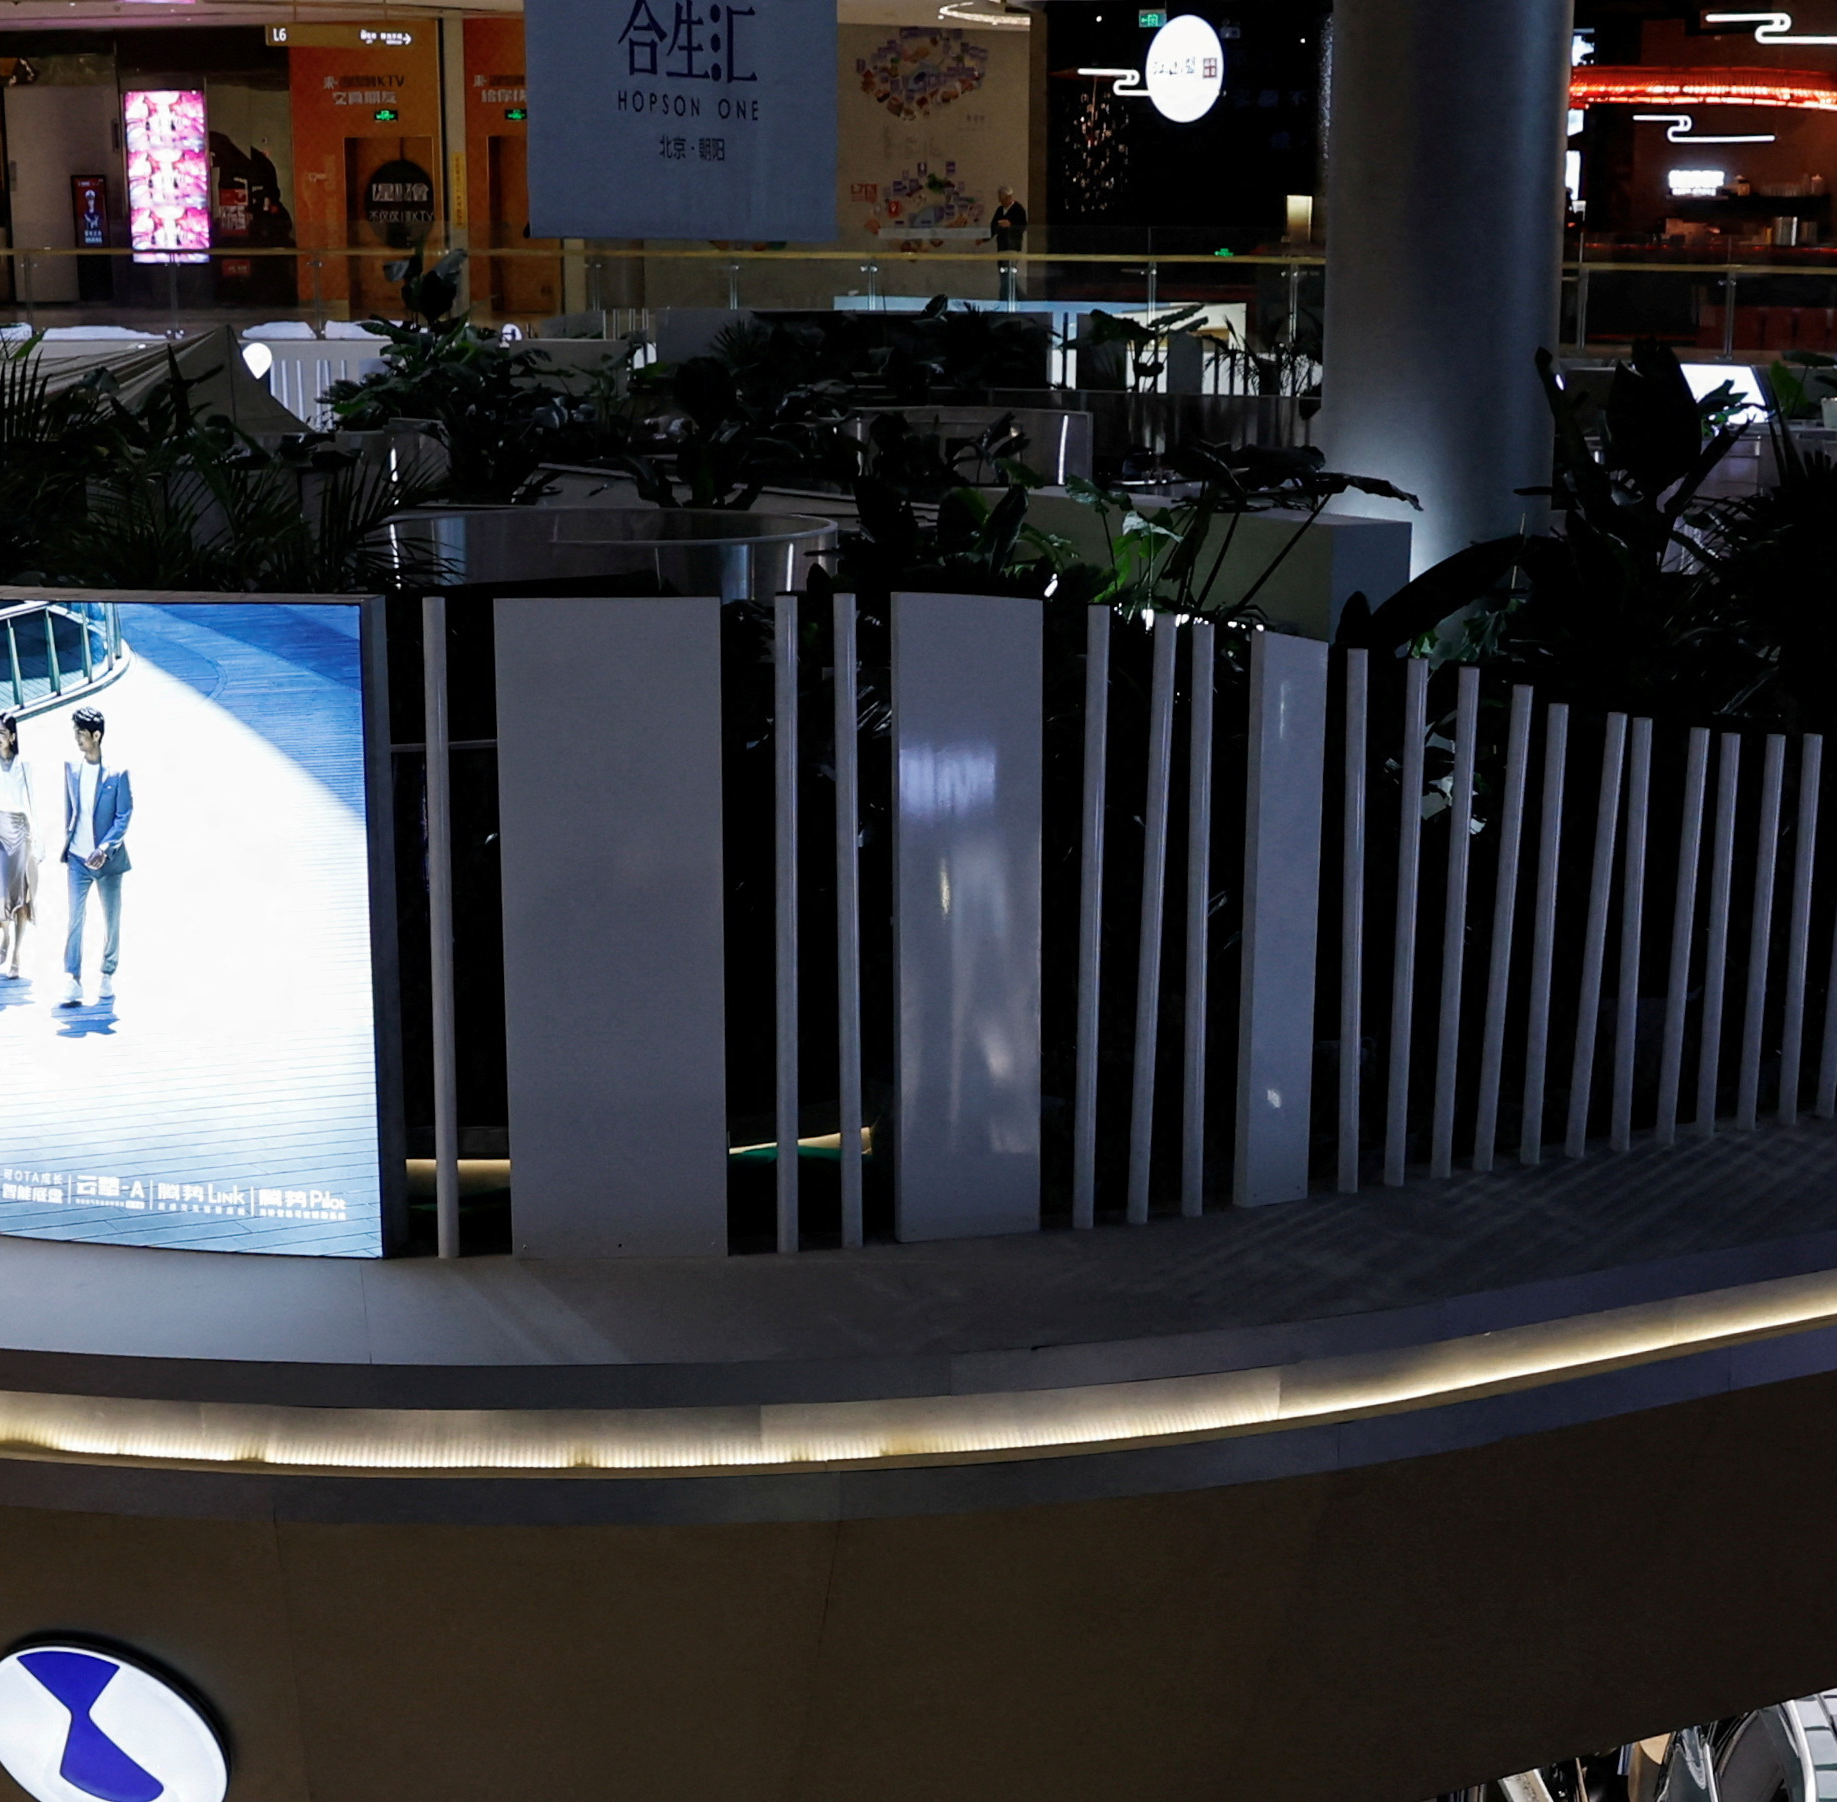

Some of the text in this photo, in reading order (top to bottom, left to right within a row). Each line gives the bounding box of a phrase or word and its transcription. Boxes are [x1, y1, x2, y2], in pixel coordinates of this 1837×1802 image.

[273, 28, 287, 42] L6
[618, 0, 758, 82] 合生汇
[617, 91, 759, 121] HOPSON ONE
[659, 135, 726, 161] 北京·朝阳
